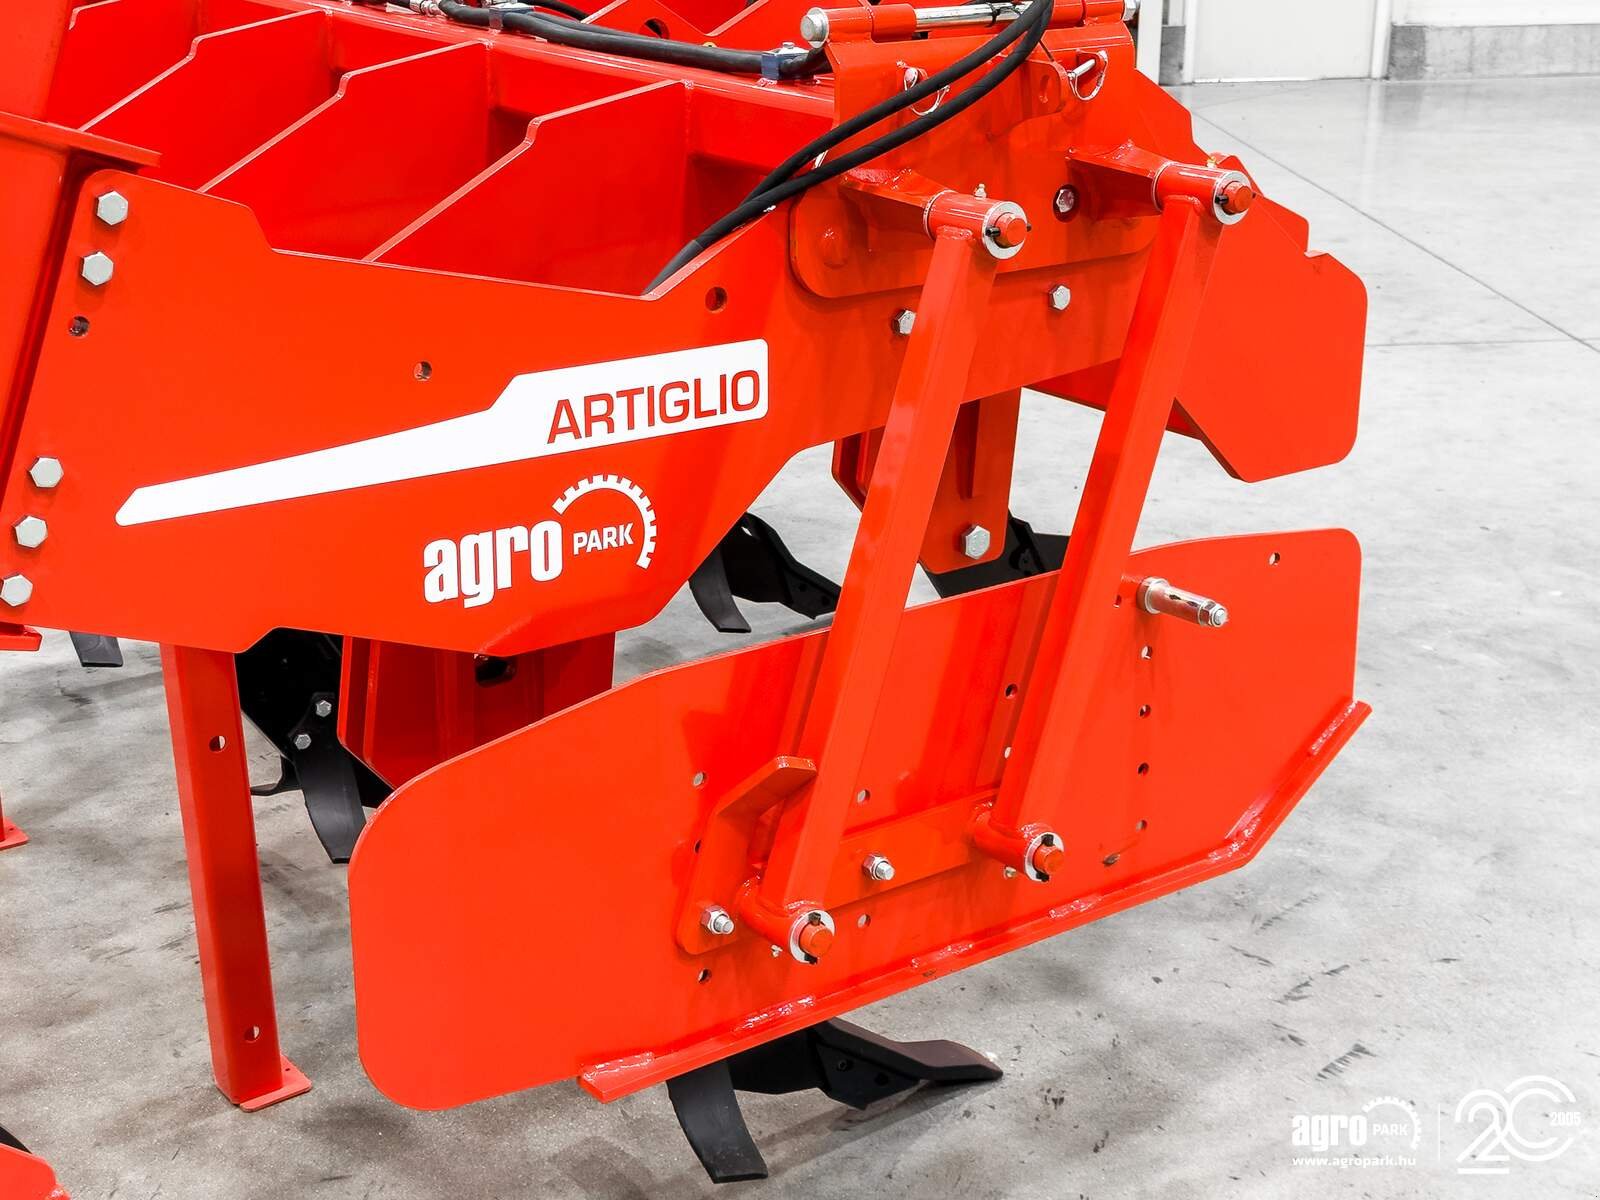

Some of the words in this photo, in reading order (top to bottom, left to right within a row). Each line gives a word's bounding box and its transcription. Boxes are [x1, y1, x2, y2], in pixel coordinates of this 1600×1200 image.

[547, 369, 760, 444] ARTIGLIO
[423, 519, 563, 609] agro
[573, 522, 634, 555] PARK
